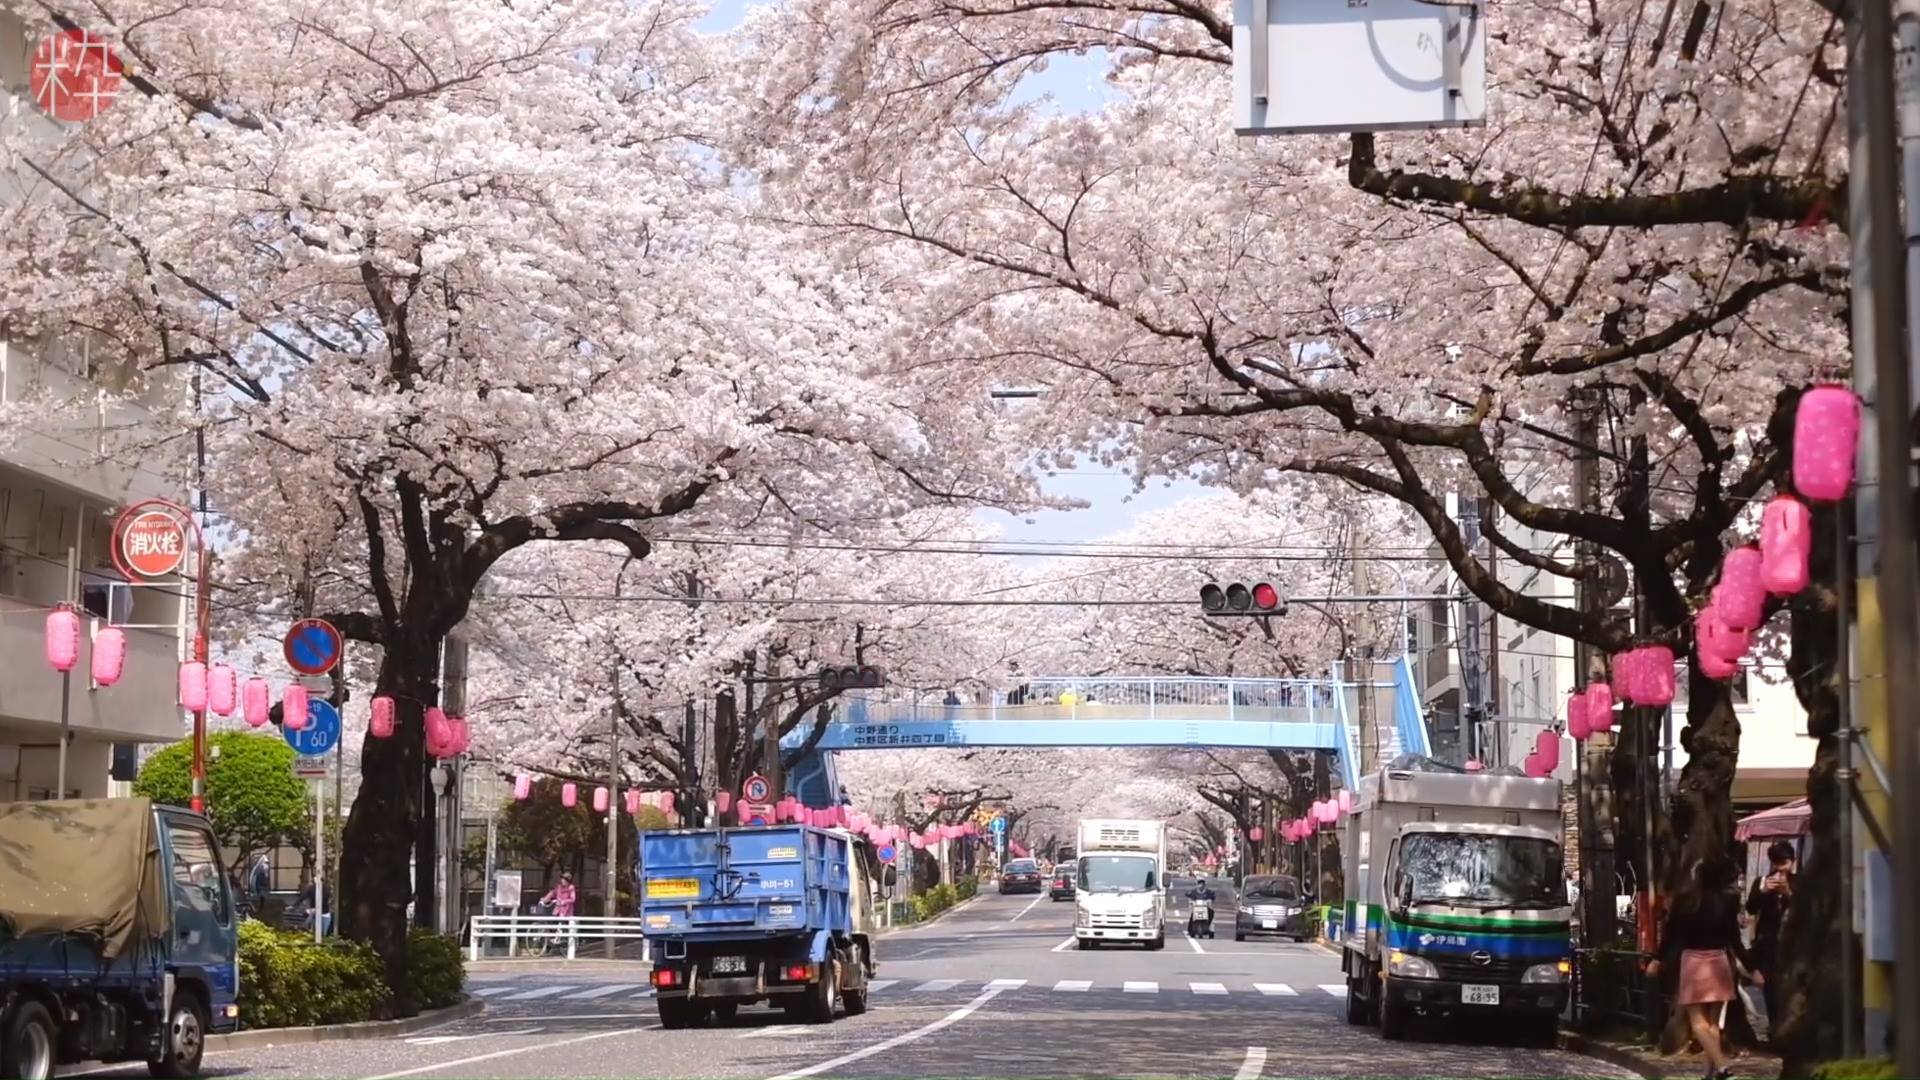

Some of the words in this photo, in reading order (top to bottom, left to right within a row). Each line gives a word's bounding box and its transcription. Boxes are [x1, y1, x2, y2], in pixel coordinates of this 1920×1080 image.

[130, 531, 180, 555] 消火栓
[295, 712, 318, 747] P
[854, 725, 899, 735] 中野通り
[310, 730, 328, 747] 60
[854, 734, 945, 744] 中野区新井四丁目
